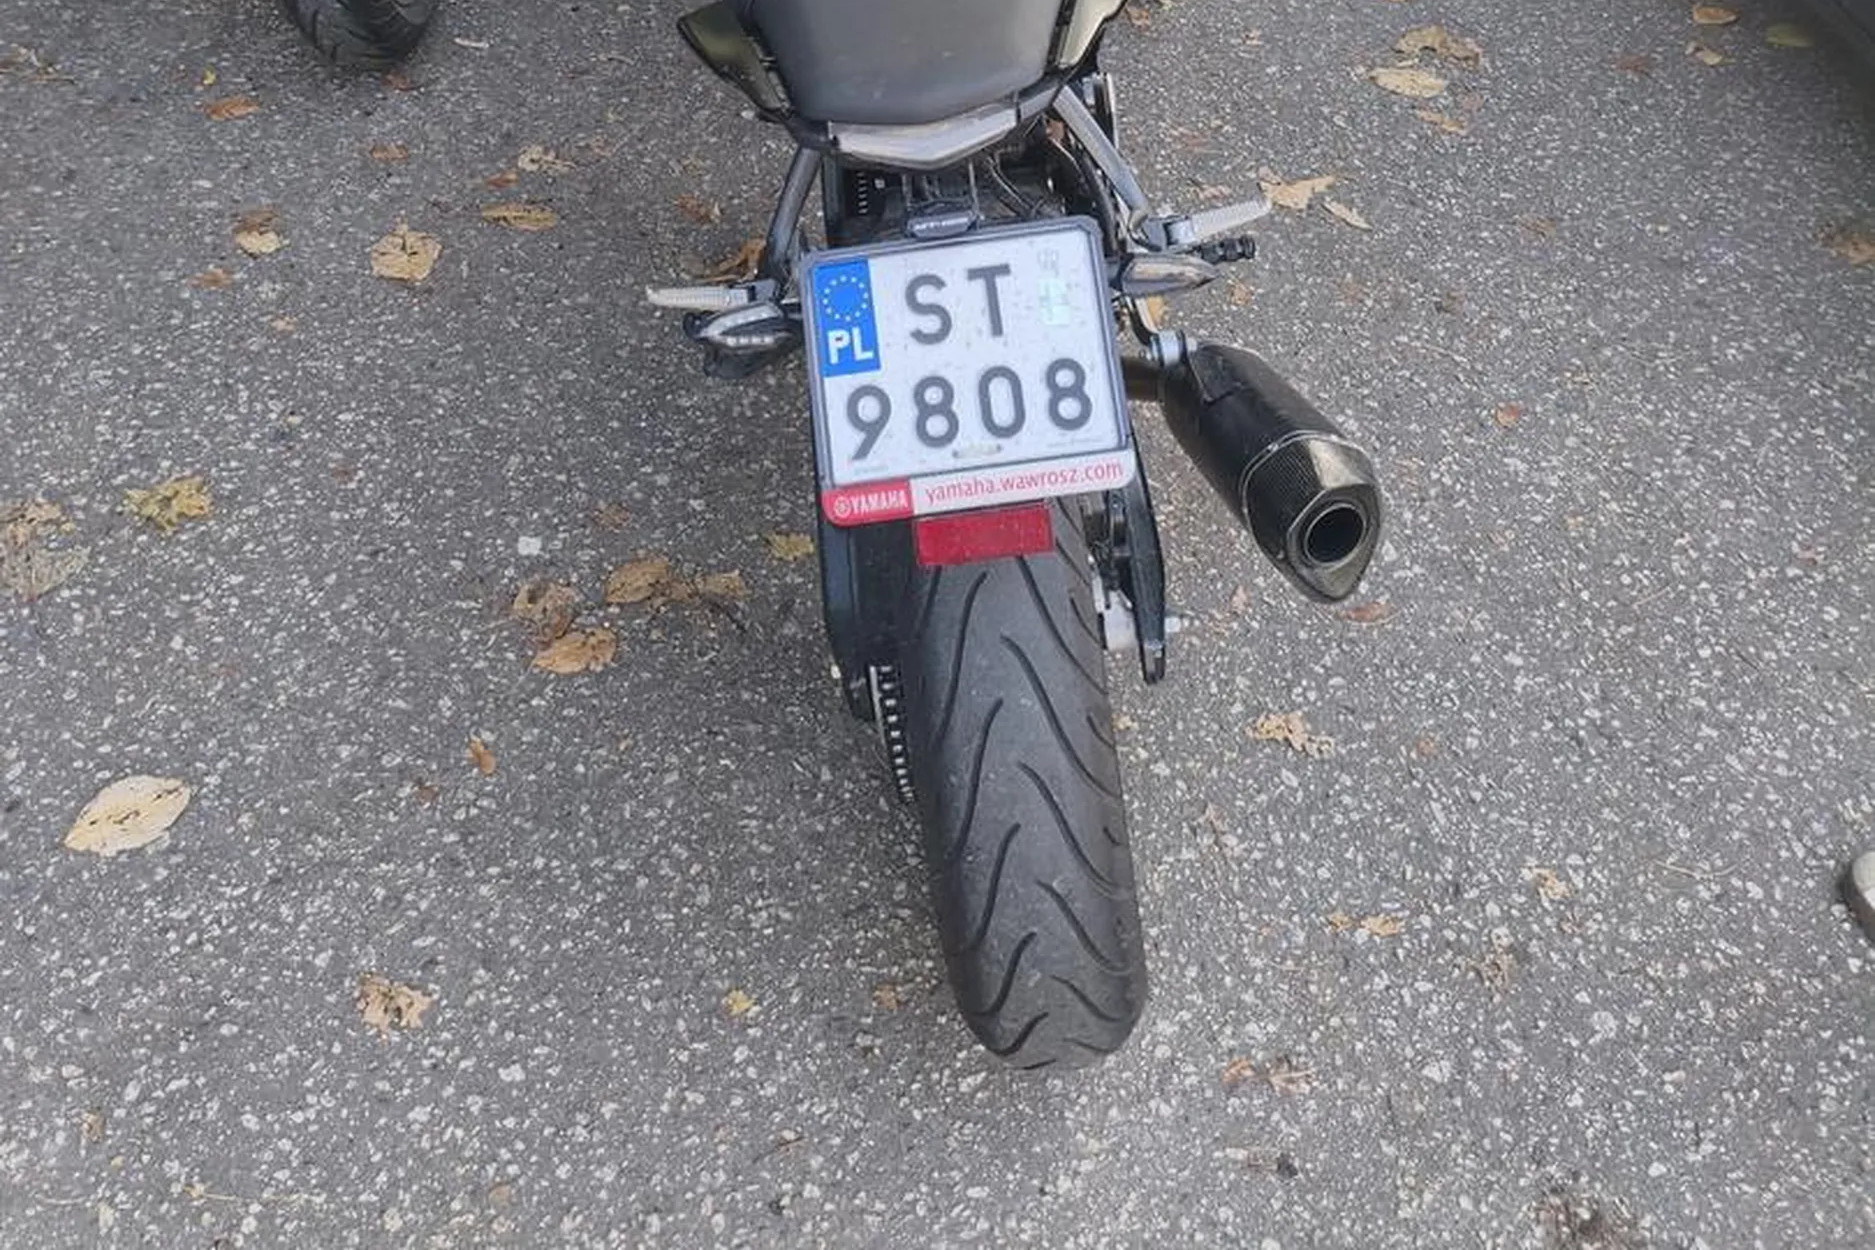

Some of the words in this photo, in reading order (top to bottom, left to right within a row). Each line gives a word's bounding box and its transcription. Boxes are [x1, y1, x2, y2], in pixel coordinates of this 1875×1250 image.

[905, 263, 1011, 345] ST
[827, 327, 874, 365] PL
[847, 358, 1093, 461] 9808
[850, 489, 909, 514] YAMAHA
[925, 459, 1124, 505] yamaha.wawrosz.com
